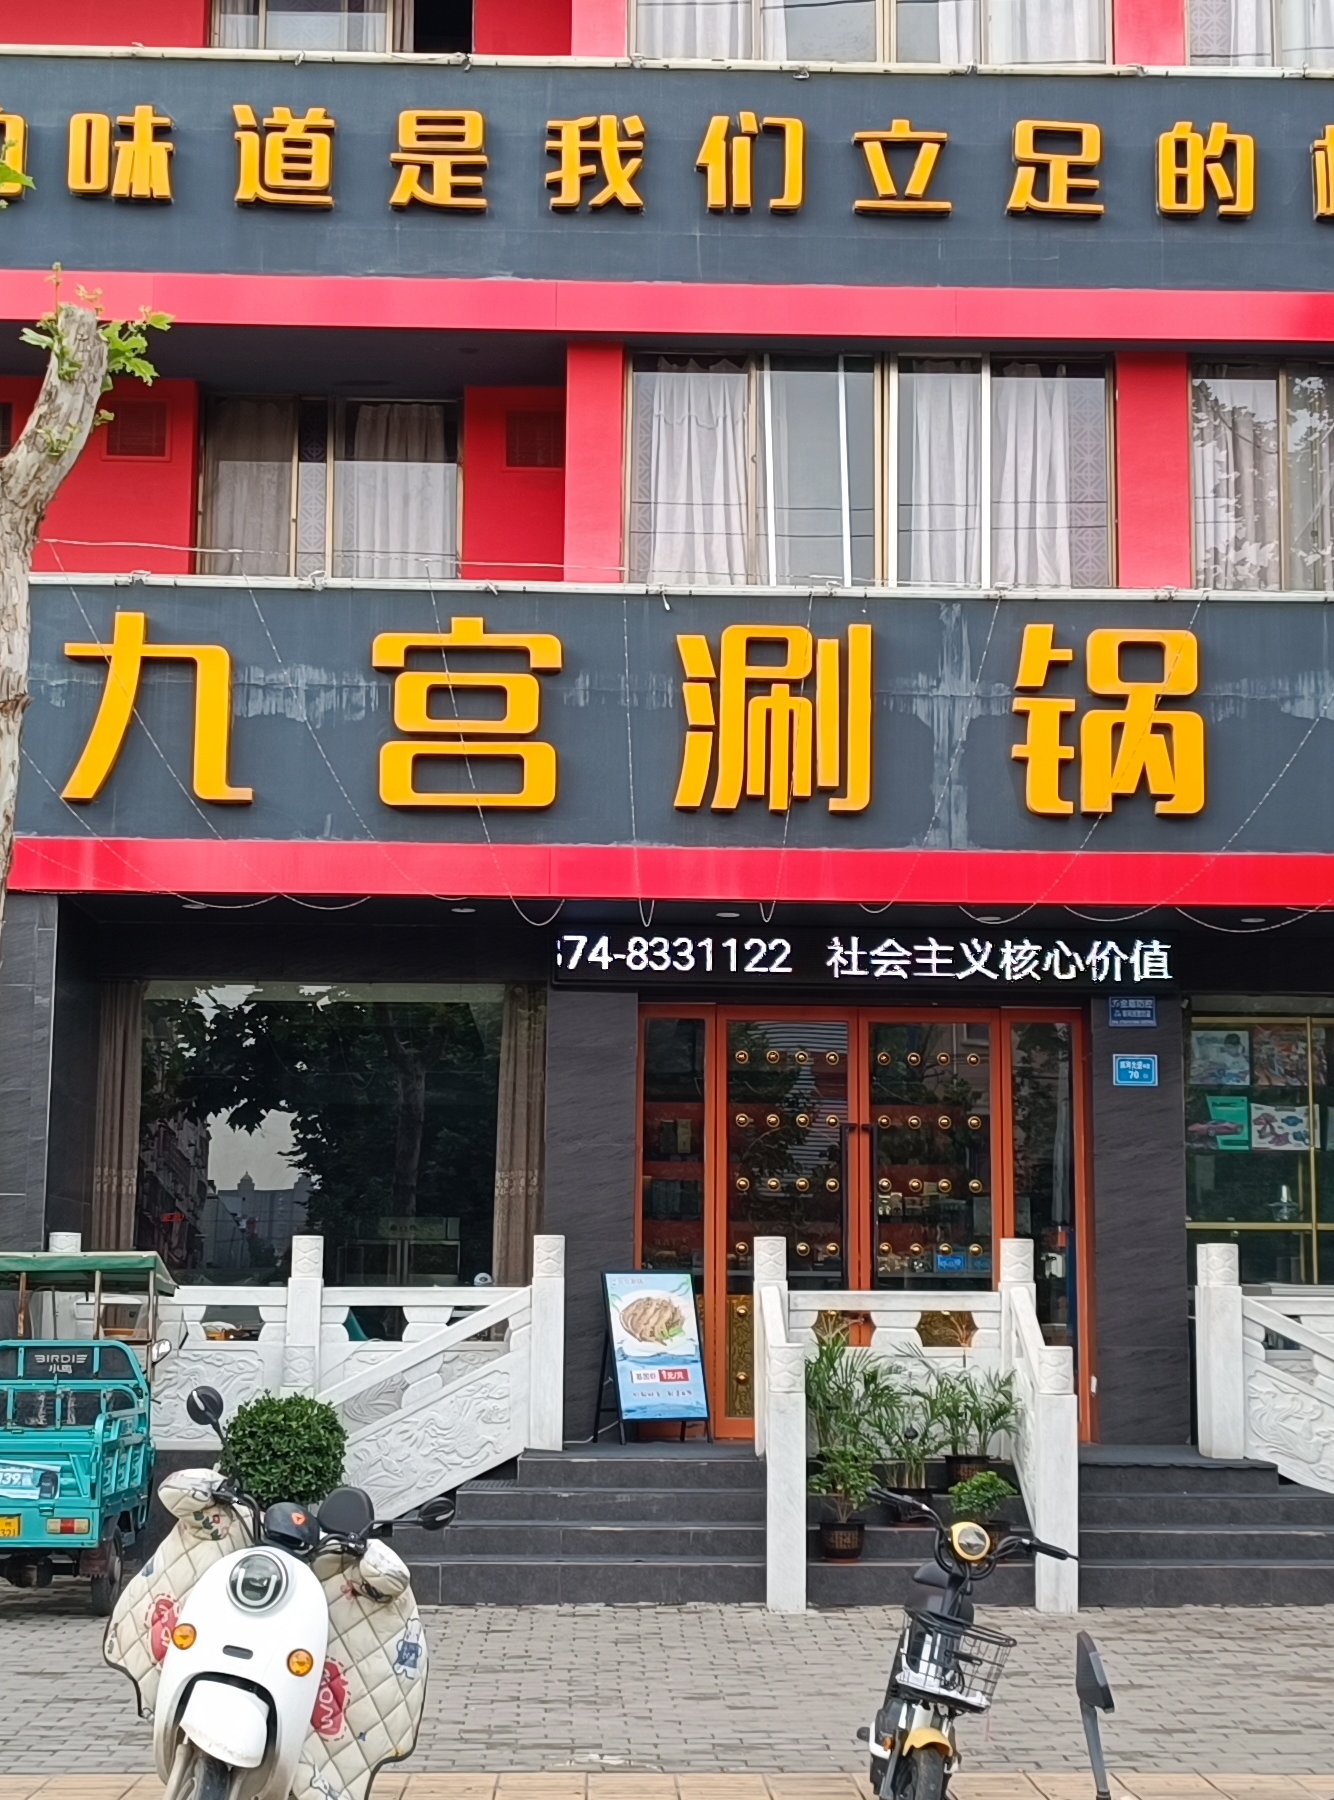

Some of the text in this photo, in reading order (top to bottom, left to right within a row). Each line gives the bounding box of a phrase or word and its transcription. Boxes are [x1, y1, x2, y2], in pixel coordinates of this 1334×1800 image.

[61, 611, 1208, 817] 九宫涮锅
[556, 935, 1174, 983] 74-8331122 社会主义核心价值
[34, 1354, 88, 1364] BIRDIE
